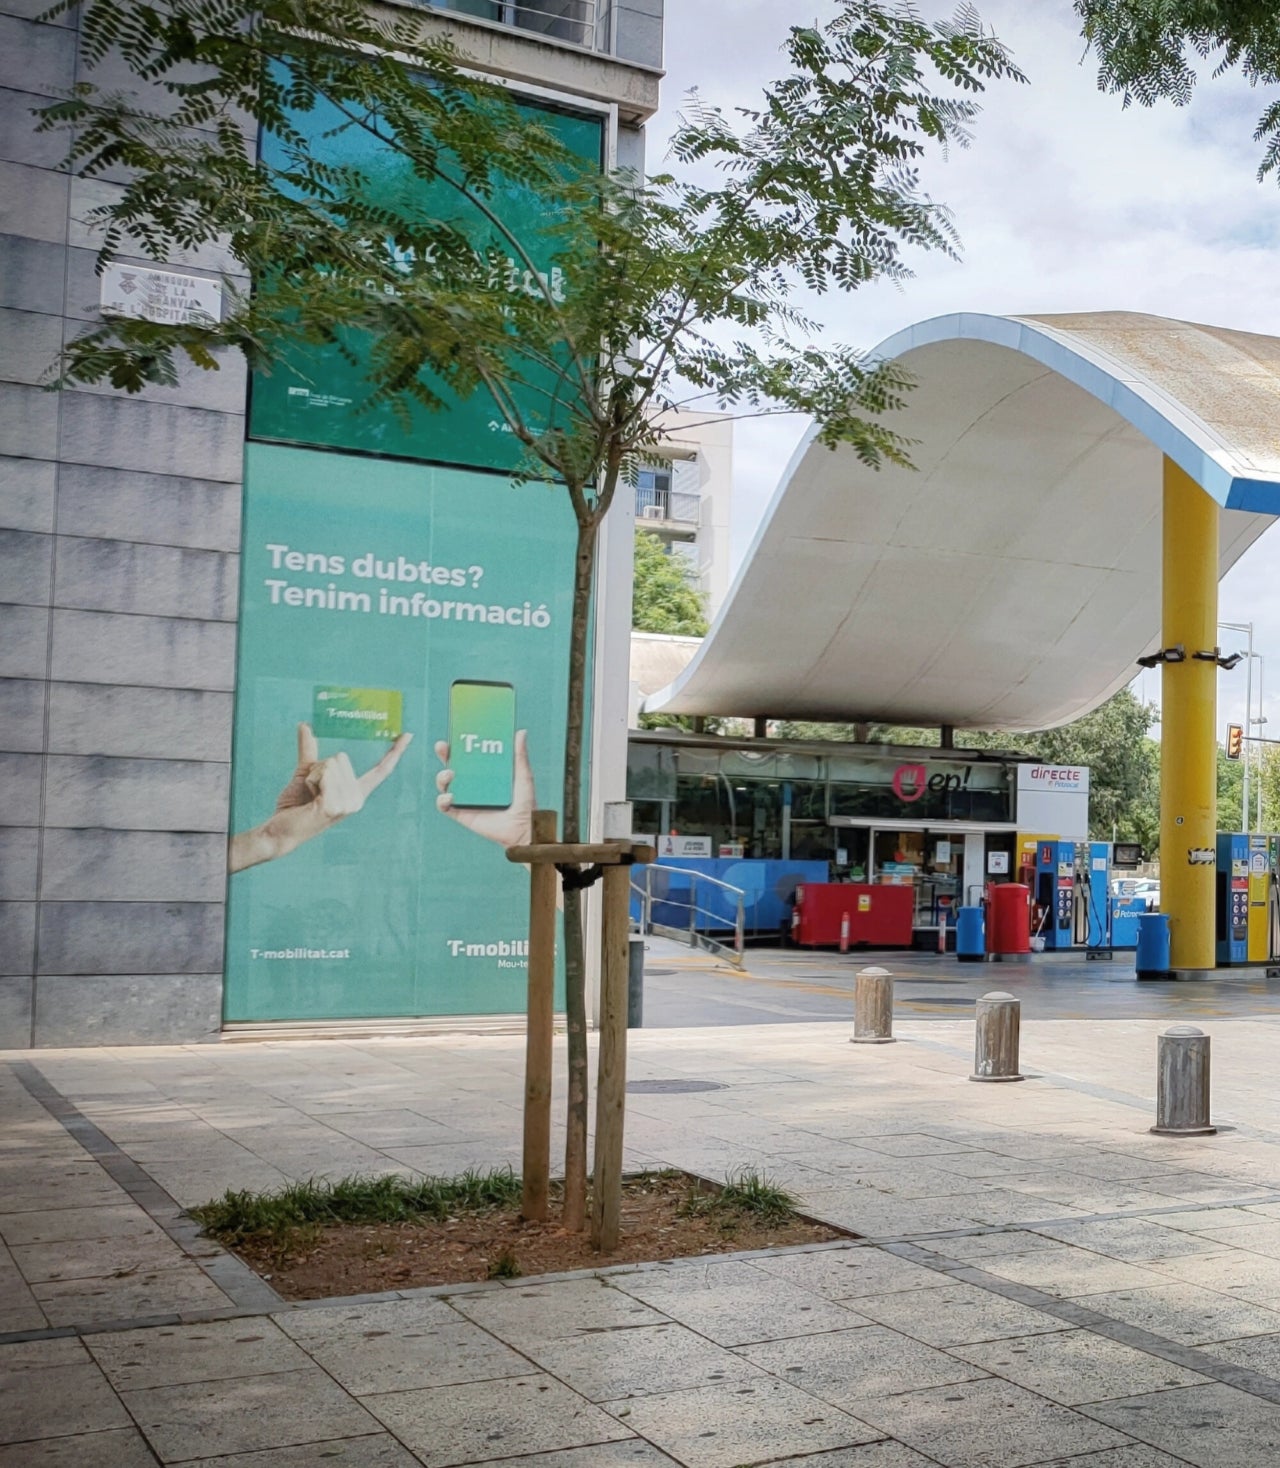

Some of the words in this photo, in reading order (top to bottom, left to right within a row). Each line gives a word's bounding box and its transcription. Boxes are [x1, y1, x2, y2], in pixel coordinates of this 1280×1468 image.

[174, 287, 187, 297] LA
[266, 544, 345, 575] Tens
[352, 553, 484, 588] dubtes?
[264, 579, 371, 612] Tenim
[379, 588, 551, 628] informació
[460, 734, 503, 754] T-m
[250, 948, 350, 960] T-mobilitat.cat
[447, 939, 557, 957] T-mobili
